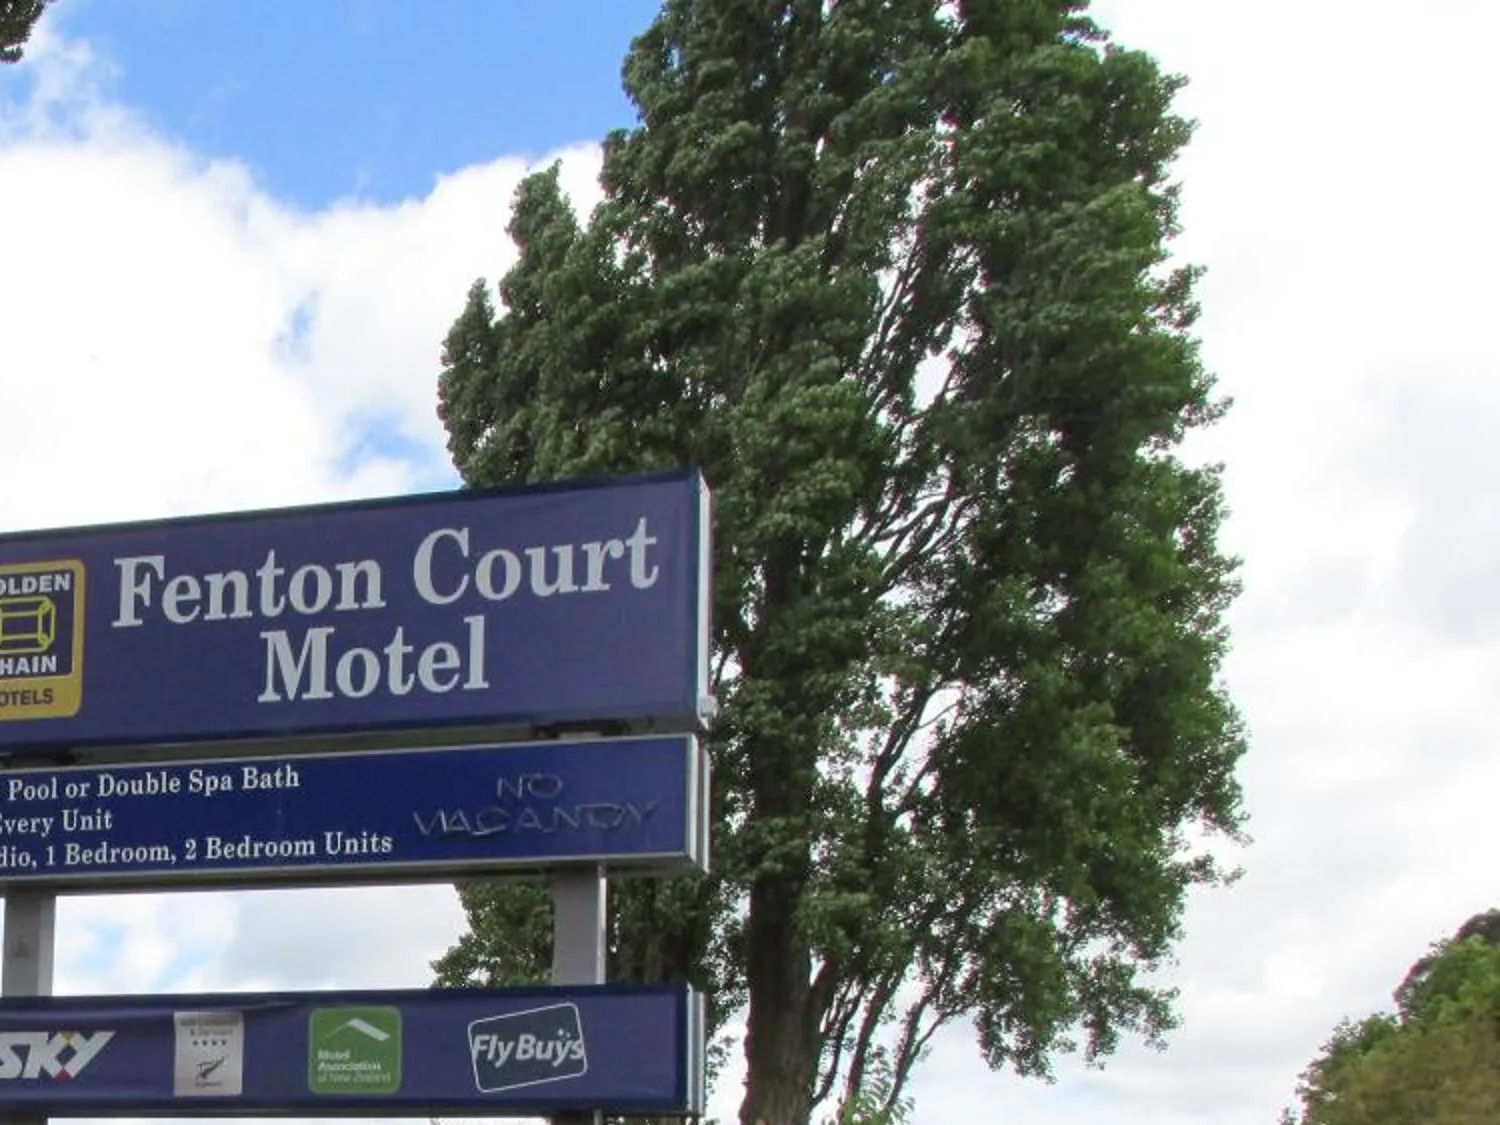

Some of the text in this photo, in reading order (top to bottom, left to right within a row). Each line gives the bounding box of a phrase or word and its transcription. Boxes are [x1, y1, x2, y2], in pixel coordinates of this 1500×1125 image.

[112, 517, 659, 627] Fenton Court
[257, 615, 490, 703] Motel
[8, 777, 58, 801] Pool
[65, 783, 91, 798] or
[98, 772, 181, 797] Double
[188, 769, 233, 797] Spa
[242, 764, 300, 790] Bath
[497, 772, 564, 800] NO
[62, 808, 113, 832] Unit
[412, 802, 660, 837] VACANCY
[45, 846, 55, 866] 1
[65, 842, 177, 865] Bedroom,
[185, 838, 197, 860] 2
[205, 836, 316, 859] Bedroom
[324, 831, 393, 854] Units
